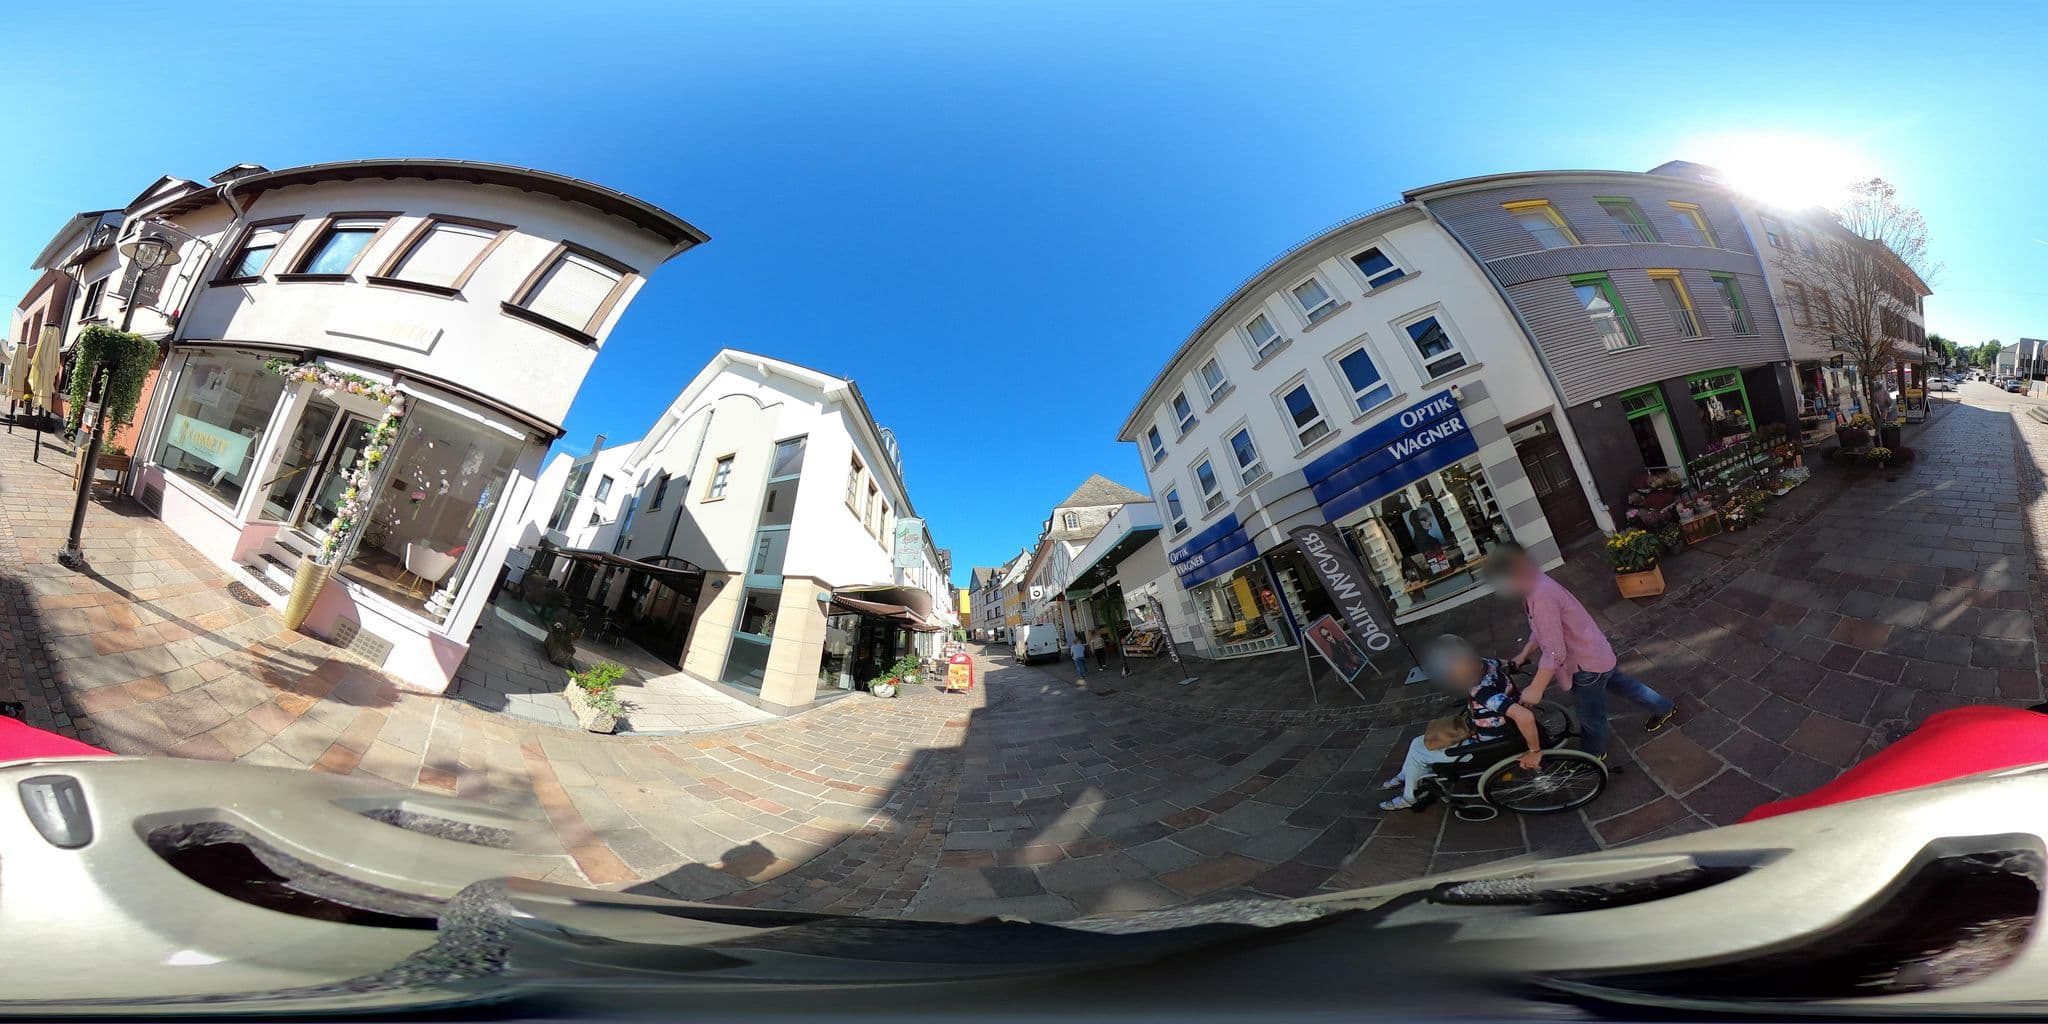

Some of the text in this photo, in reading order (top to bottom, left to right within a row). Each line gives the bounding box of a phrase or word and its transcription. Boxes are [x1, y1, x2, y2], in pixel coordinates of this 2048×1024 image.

[1400, 396, 1453, 428] OPTIK
[1388, 417, 1464, 460] WAGNER
[1170, 547, 1189, 563] OPTIK
[1175, 555, 1205, 575] WAGNER
